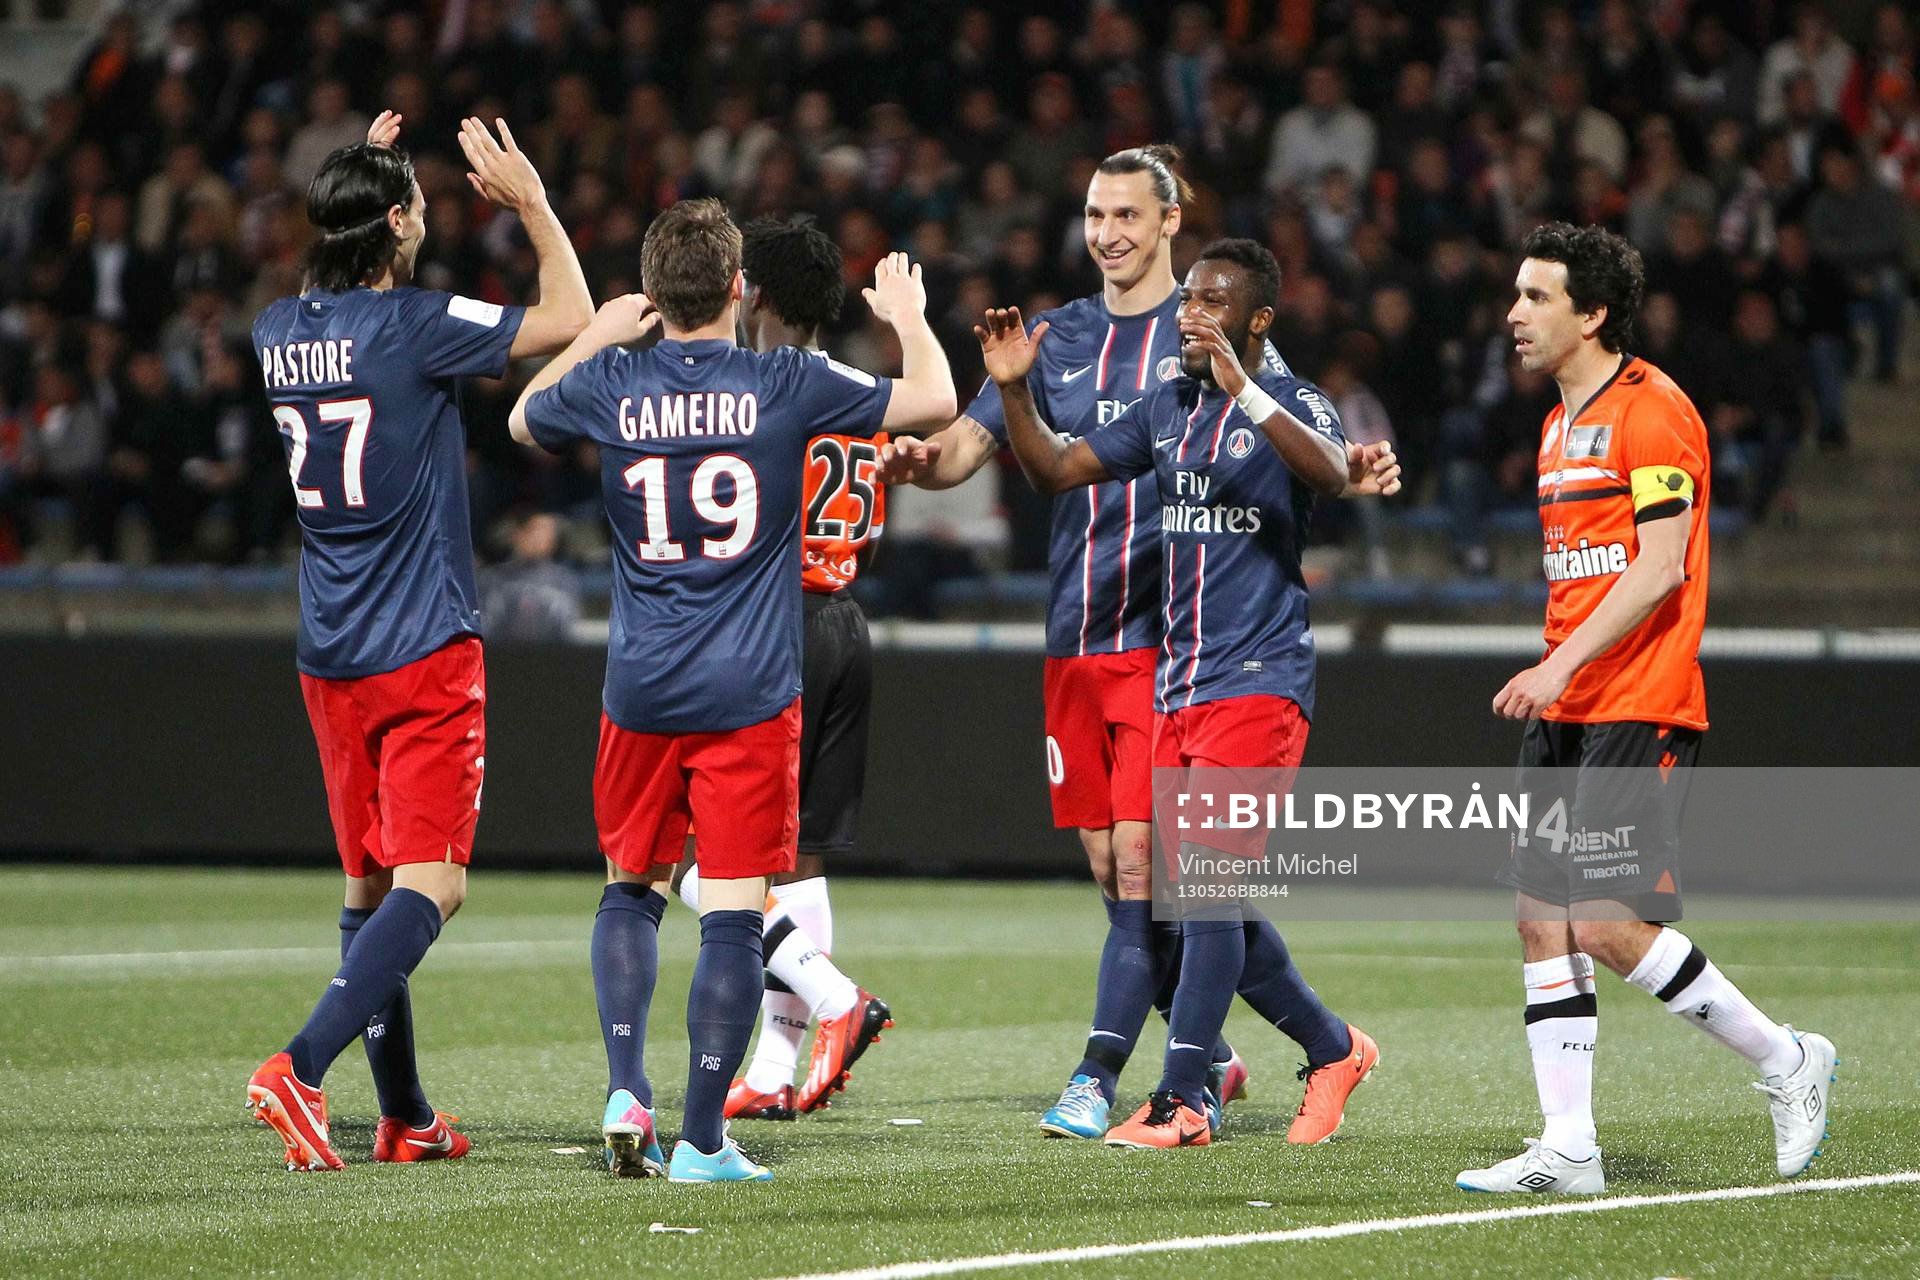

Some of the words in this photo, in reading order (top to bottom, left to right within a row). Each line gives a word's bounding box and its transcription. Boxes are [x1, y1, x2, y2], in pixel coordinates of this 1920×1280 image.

[262, 339, 353, 388] PASTORE
[618, 392, 758, 442] GAMEIRO
[273, 398, 371, 507] 27
[805, 437, 877, 543] 25
[1176, 470, 1211, 501] Fly
[621, 451, 760, 564] 19
[1162, 499, 1262, 534] mirates
[1583, 862, 1640, 880] macron
[366, 1023, 386, 1040] PSG
[612, 1023, 631, 1037] PSG
[1562, 1041, 1580, 1051] FC
[700, 1053, 721, 1072] PSG
